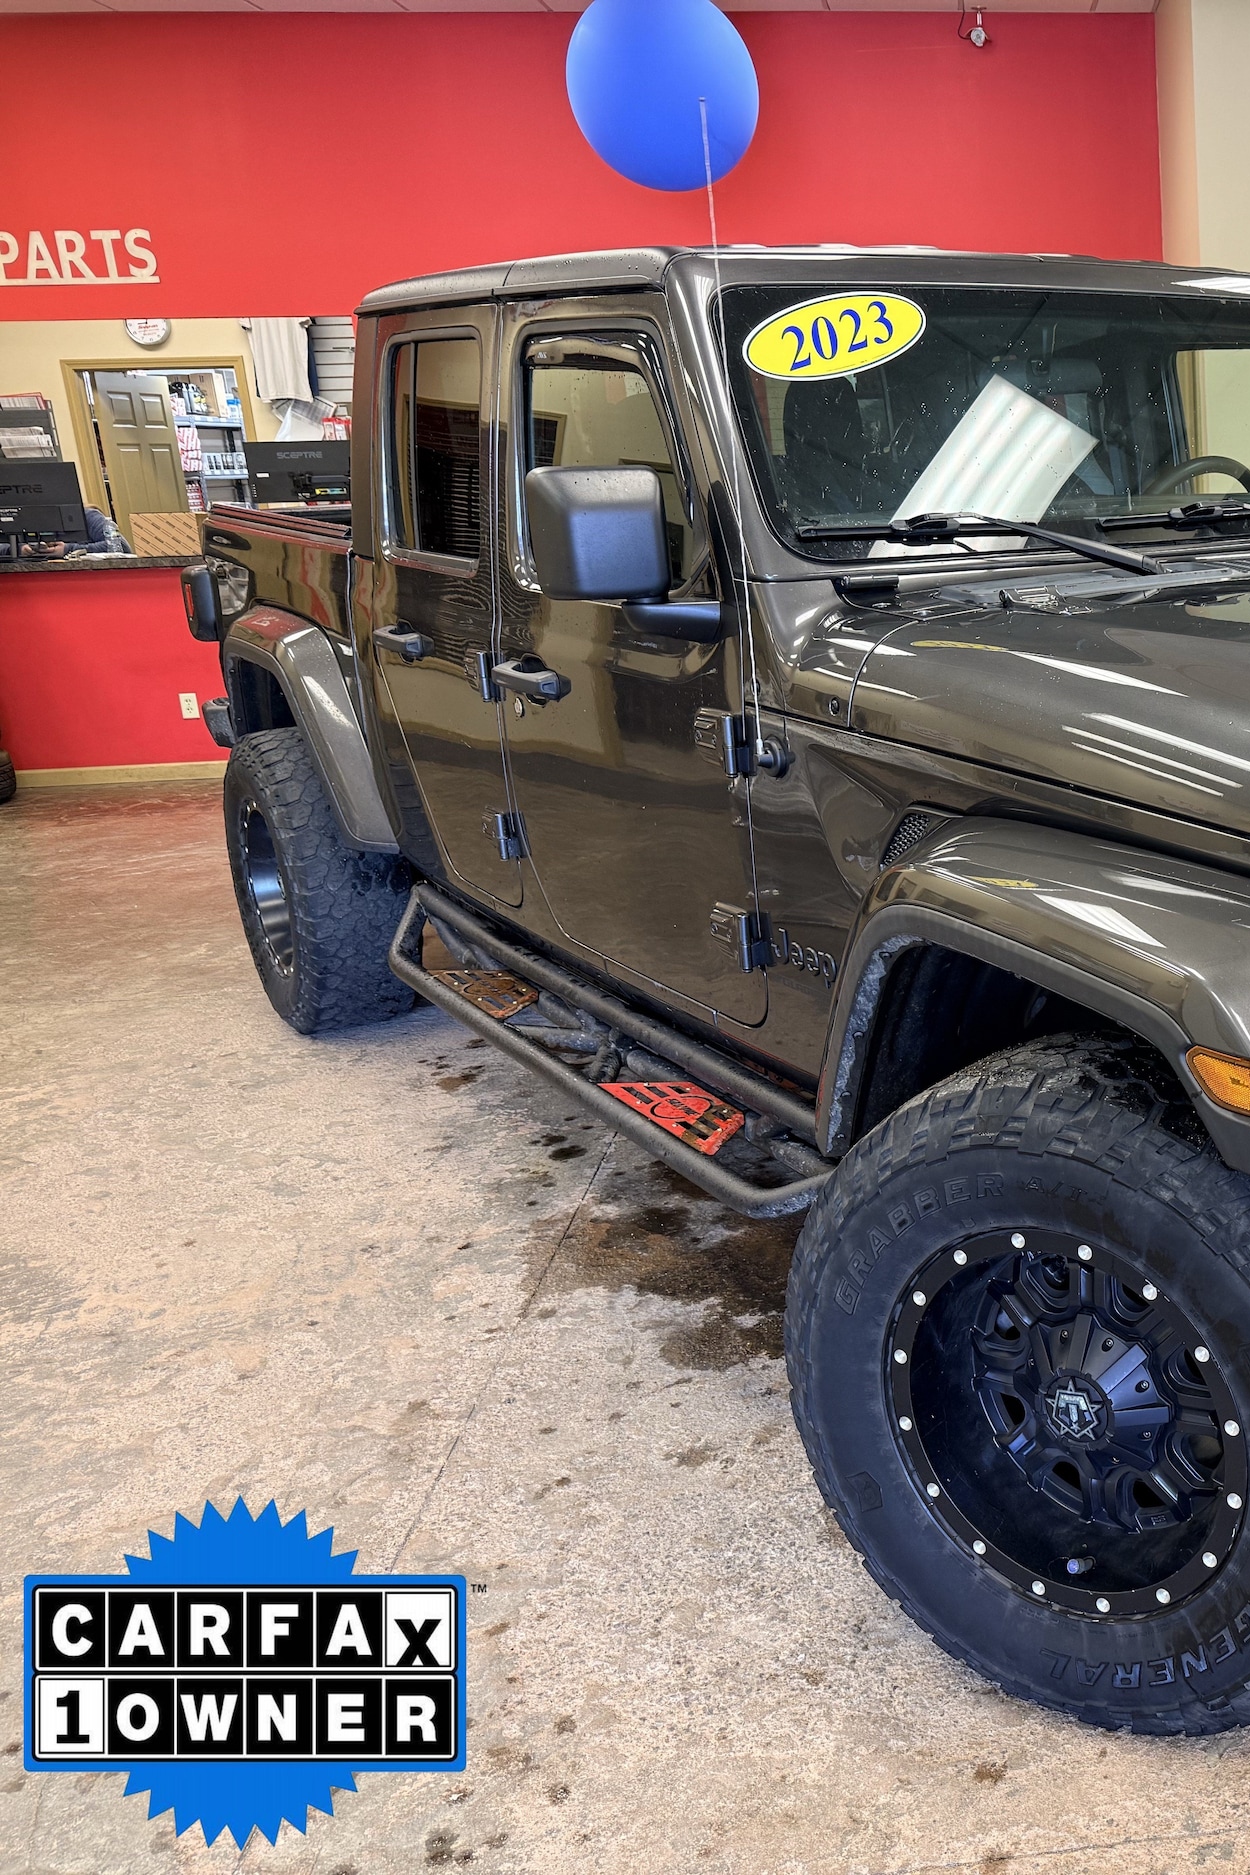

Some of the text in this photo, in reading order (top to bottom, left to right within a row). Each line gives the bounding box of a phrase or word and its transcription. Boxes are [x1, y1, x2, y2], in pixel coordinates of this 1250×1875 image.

[781, 300, 894, 372] 2023
[276, 451, 323, 459] SCEPTRE
[770, 926, 838, 990] Jeep
[833, 1172, 1005, 1317] GRABBER
